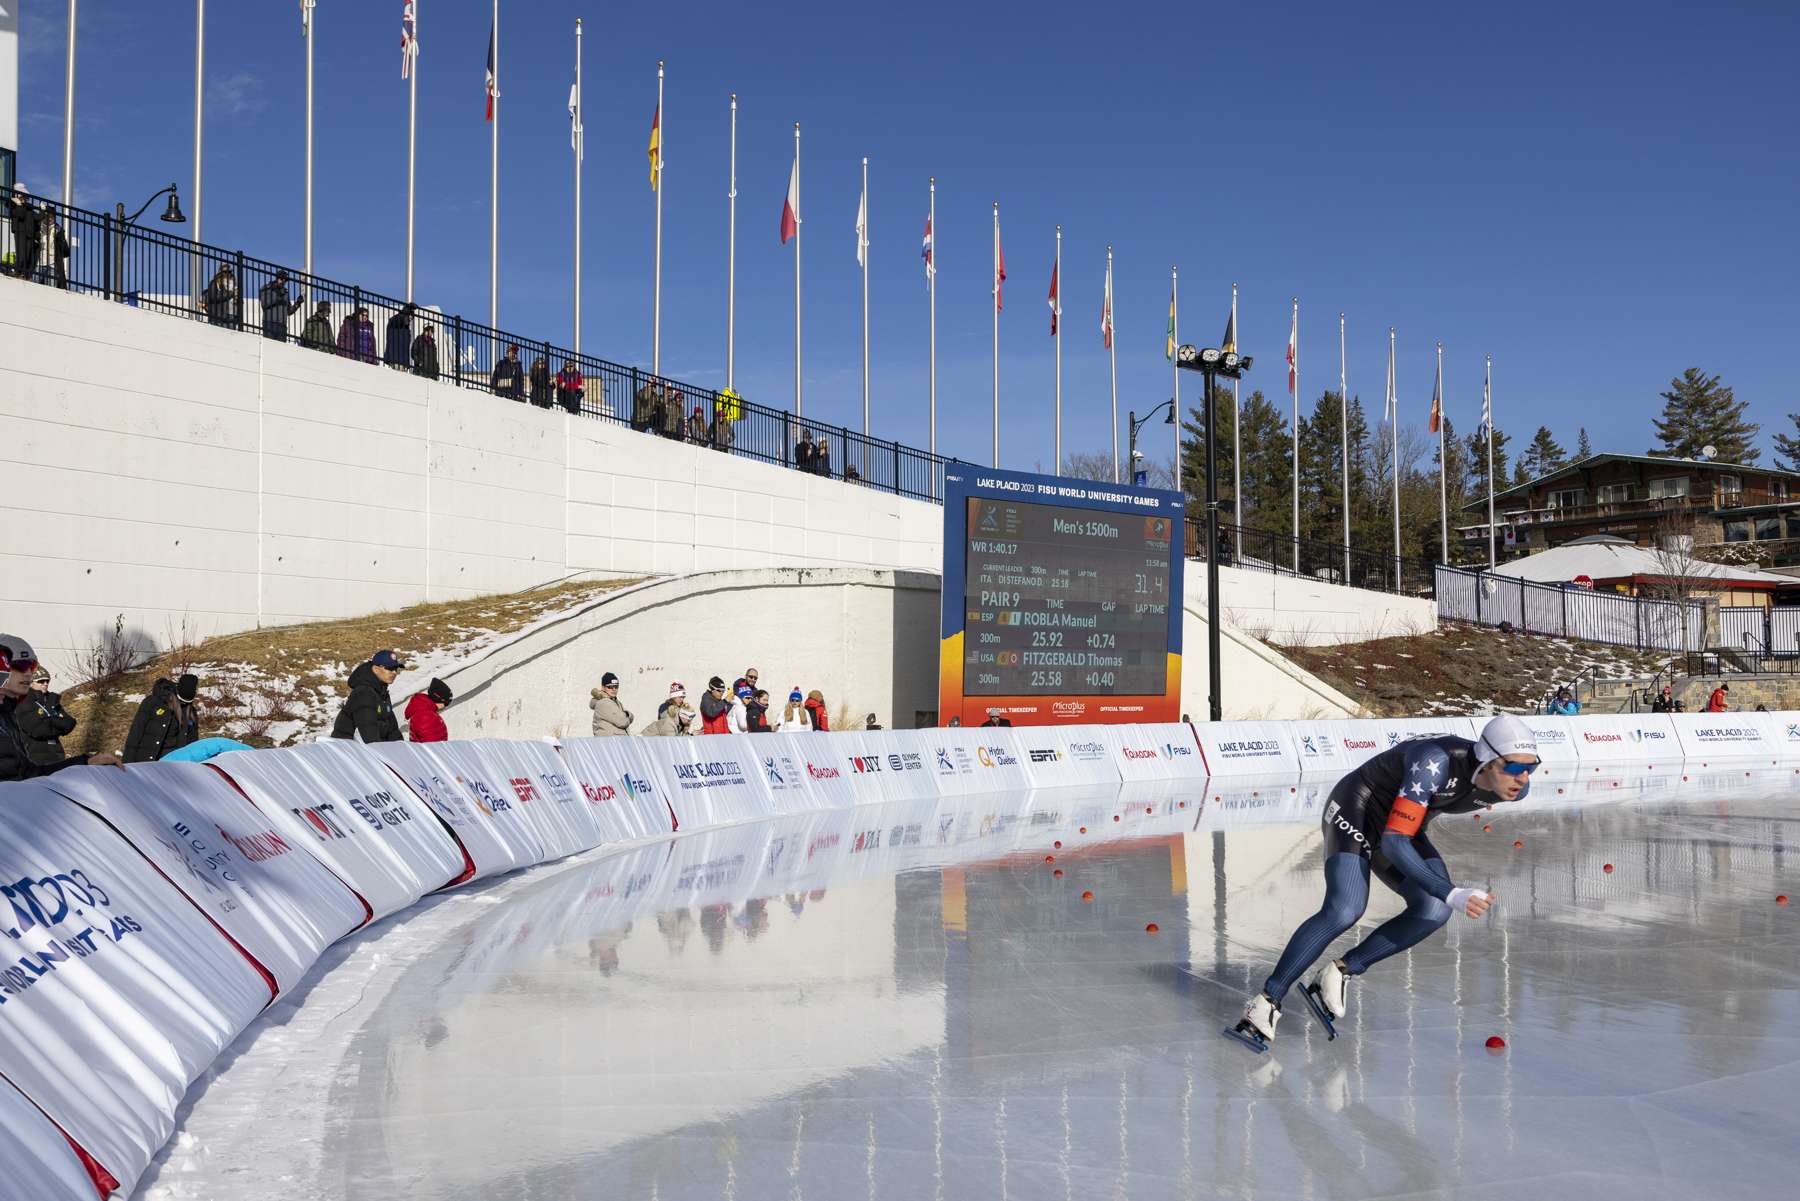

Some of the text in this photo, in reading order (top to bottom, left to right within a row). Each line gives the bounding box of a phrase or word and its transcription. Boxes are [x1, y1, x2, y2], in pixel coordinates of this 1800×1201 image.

[977, 478, 995, 488] LAKE
[996, 480, 1019, 491] PLACID
[1020, 483, 1035, 493] 2023
[1038, 485, 1056, 495] FISU
[1058, 487, 1086, 498] WORLD
[1088, 490, 1133, 503] UNIVERSITY
[1134, 496, 1159, 507] GAMES
[1053, 518, 1118, 538] Men's 1500m
[972, 541, 1017, 554] WR 1:40.17
[980, 574, 992, 583] ITA
[981, 590, 1020, 607] PAIR 9
[1046, 599, 1064, 609] TIME
[1135, 604, 1164, 614] LAP TIME
[981, 612, 994, 621] ESP
[1024, 612, 1097, 628] ROBLA Manuel
[980, 632, 1115, 648] 300m 25.92 +0.74
[980, 654, 994, 662] USA
[1023, 652, 1123, 667] FITZGERALD Thomas
[979, 671, 1114, 686] 300m 25.58 +0.40
[1716, 728, 1742, 736] PLACID
[1218, 740, 1279, 752] LAKE PLACID 2023
[1349, 740, 1376, 749] QIAODAN
[1129, 750, 1158, 759] QIAODAN
[1173, 747, 1191, 755] FISU
[901, 753, 920, 762] OLYMPIC
[673, 764, 697, 778] LAKE
[723, 761, 741, 775] 2023
[862, 756, 882, 773] NY
[904, 762, 922, 770] CENTER
[813, 767, 841, 778] QIAODAN
